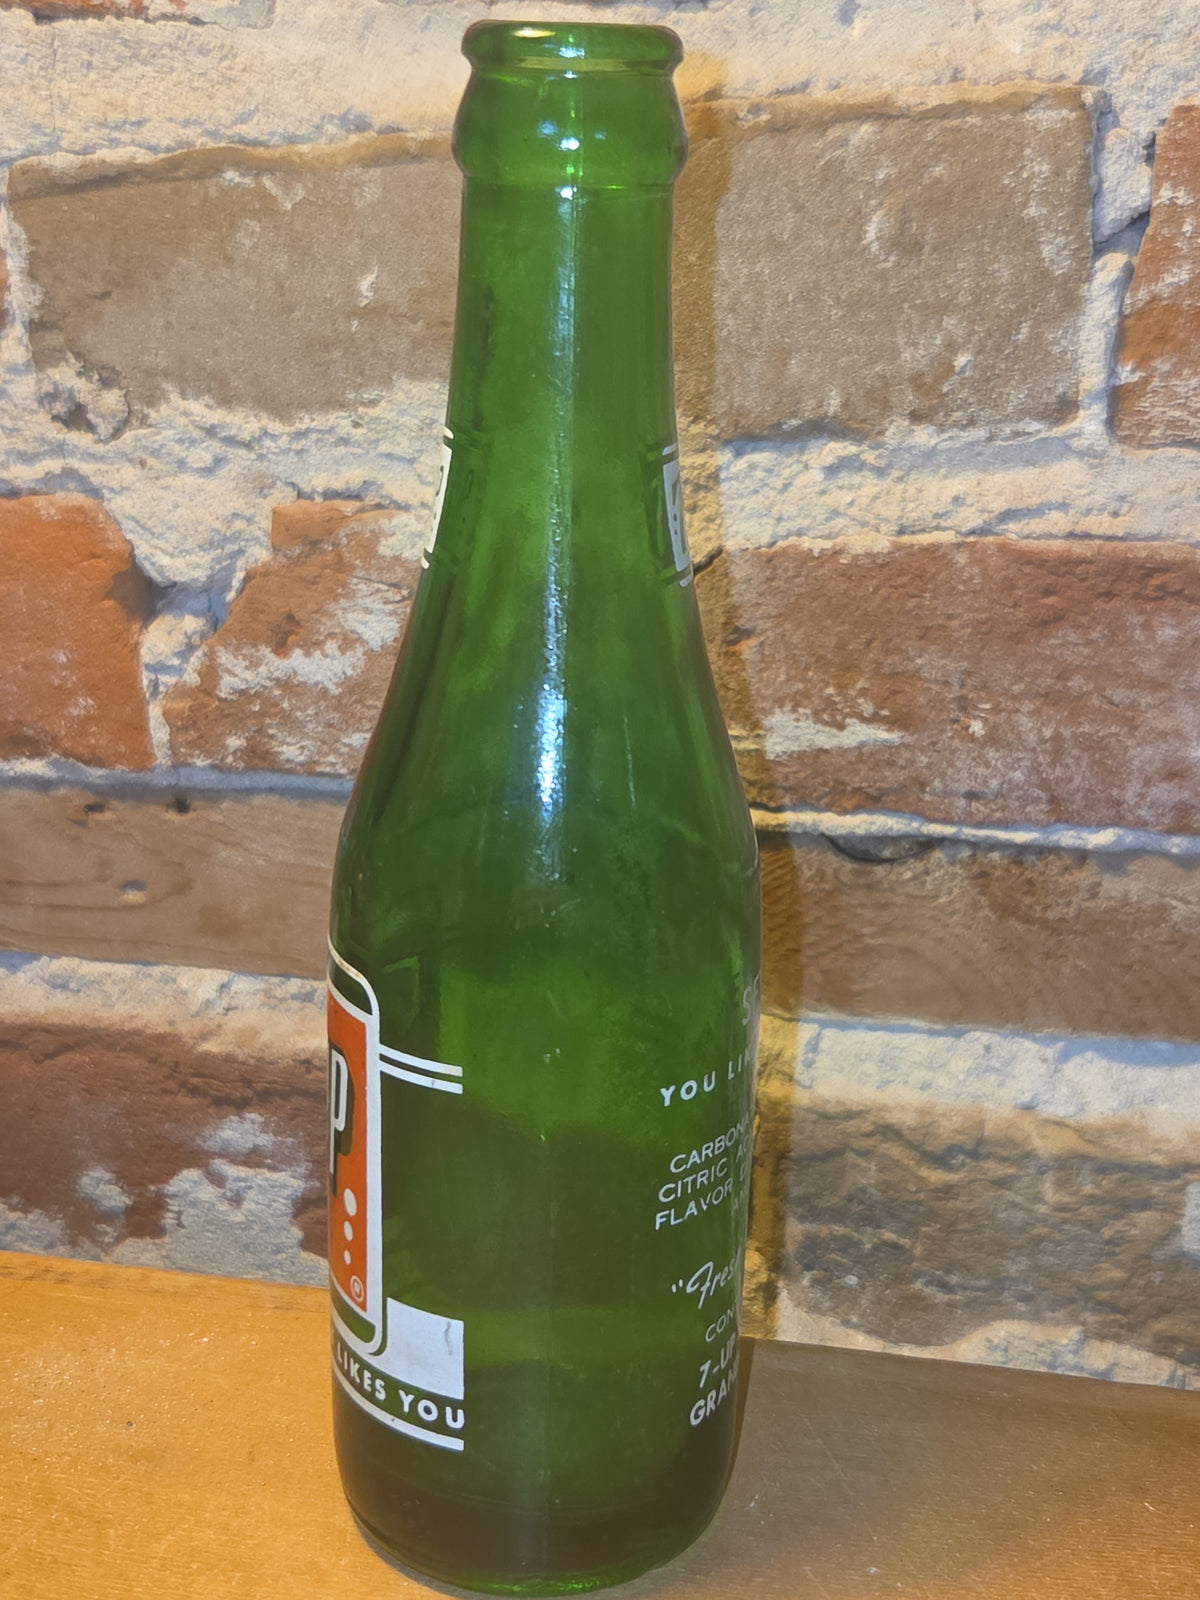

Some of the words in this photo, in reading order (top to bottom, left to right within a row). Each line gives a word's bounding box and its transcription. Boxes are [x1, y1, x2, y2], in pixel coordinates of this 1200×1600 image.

[660, 1070, 717, 1107] YOU
[670, 1112, 751, 1174] CARBONA
[655, 1178, 733, 1231] FLAVOR
[658, 1158, 728, 1203] CITRIC
[337, 1340, 387, 1401] LIKES
[398, 1389, 466, 1430] YOU
[699, 1331, 737, 1389] 7-UP
